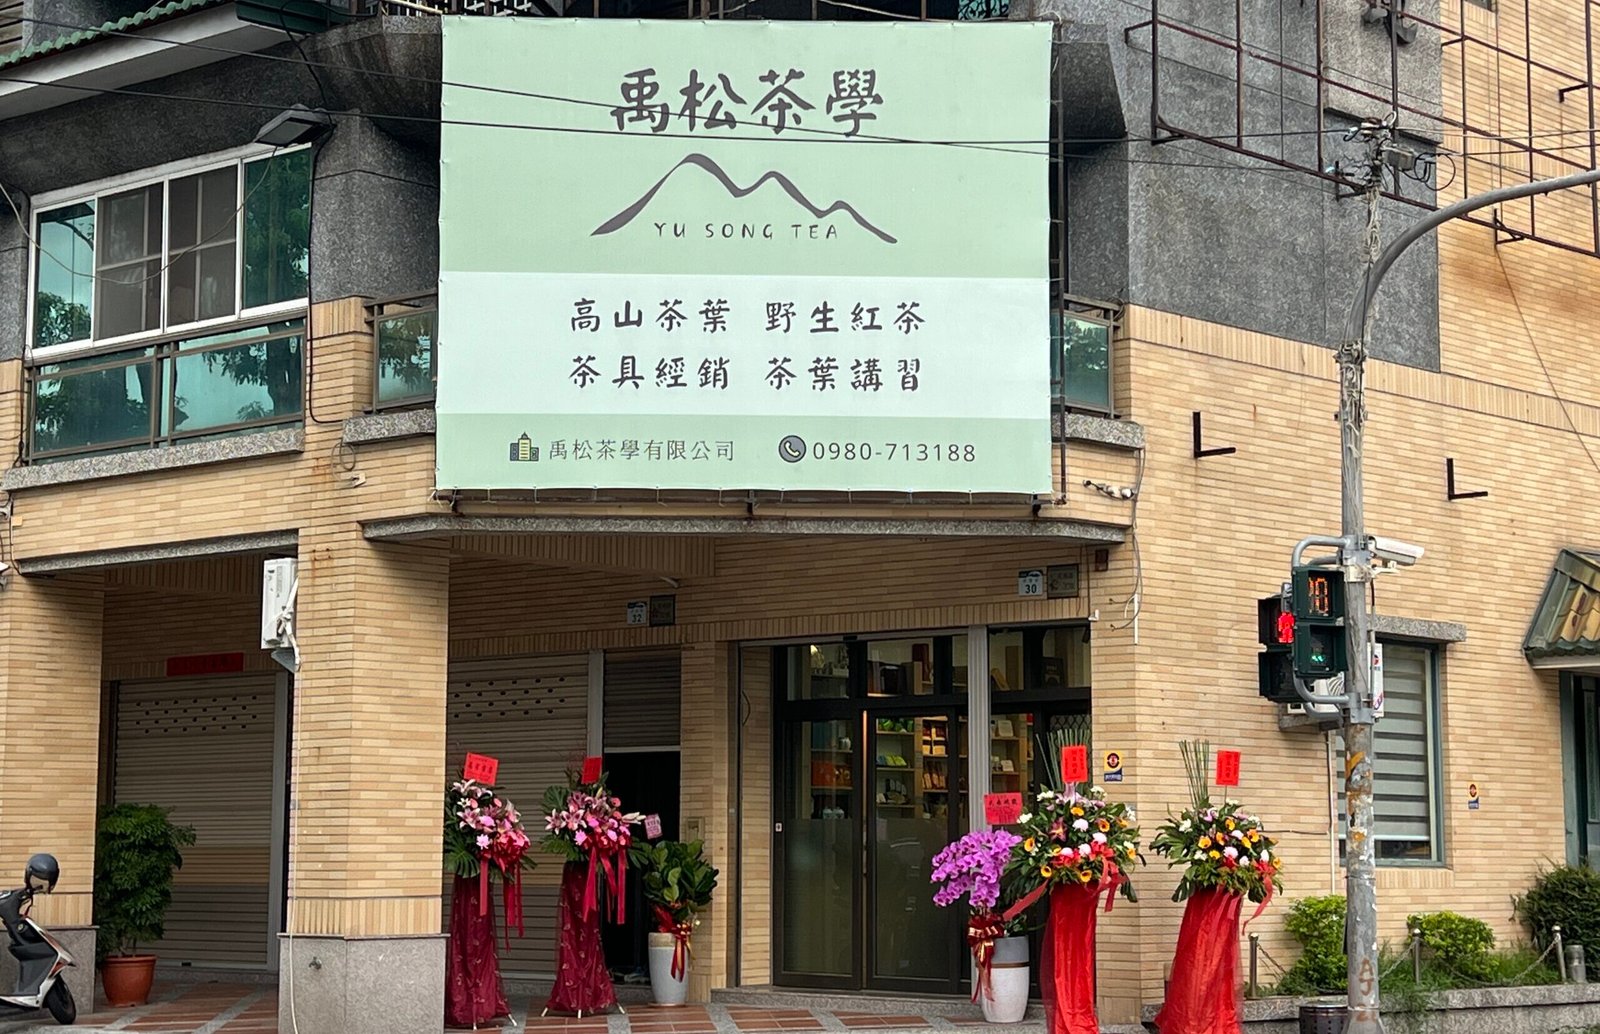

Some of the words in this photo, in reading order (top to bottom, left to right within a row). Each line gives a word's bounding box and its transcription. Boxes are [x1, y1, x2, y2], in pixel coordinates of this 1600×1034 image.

[610, 68, 885, 136] 禹松茶學
[653, 222, 687, 238] YU
[704, 222, 774, 240] SONG
[791, 223, 839, 240] TEA
[570, 298, 731, 334] 高山茶葉
[765, 301, 926, 335] 野生紅茶
[568, 355, 730, 391] 茶具經銷
[764, 356, 920, 393] 茶葉講習
[549, 438, 735, 462] 禹松茶學有限公司
[812, 442, 976, 463] 0980-713188
[1025, 584, 1037, 594] 30
[631, 614, 642, 623] 32
